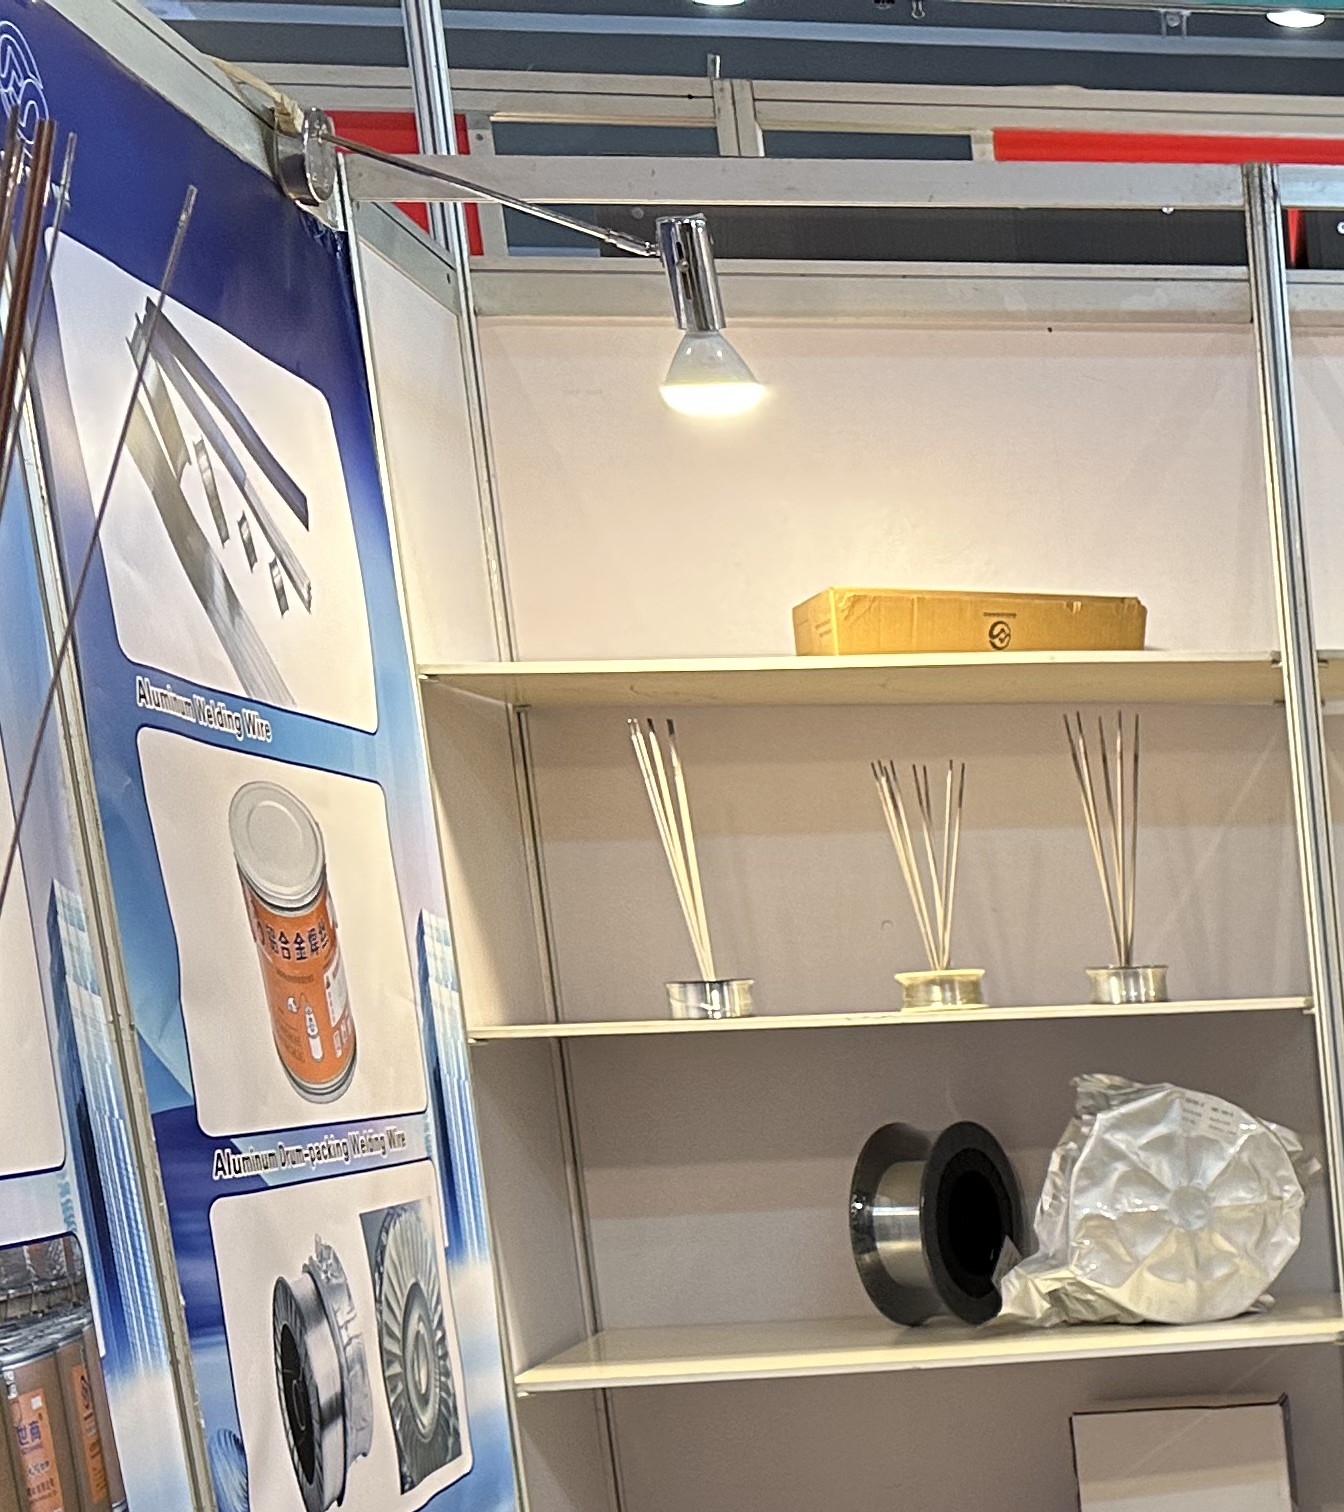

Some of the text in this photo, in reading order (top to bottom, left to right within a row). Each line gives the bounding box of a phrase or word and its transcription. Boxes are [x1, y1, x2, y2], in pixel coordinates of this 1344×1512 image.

[137, 676, 272, 742] Aluminum Welding Wire
[348, 1129, 387, 1158] Welding
[386, 1126, 407, 1150] Wire
